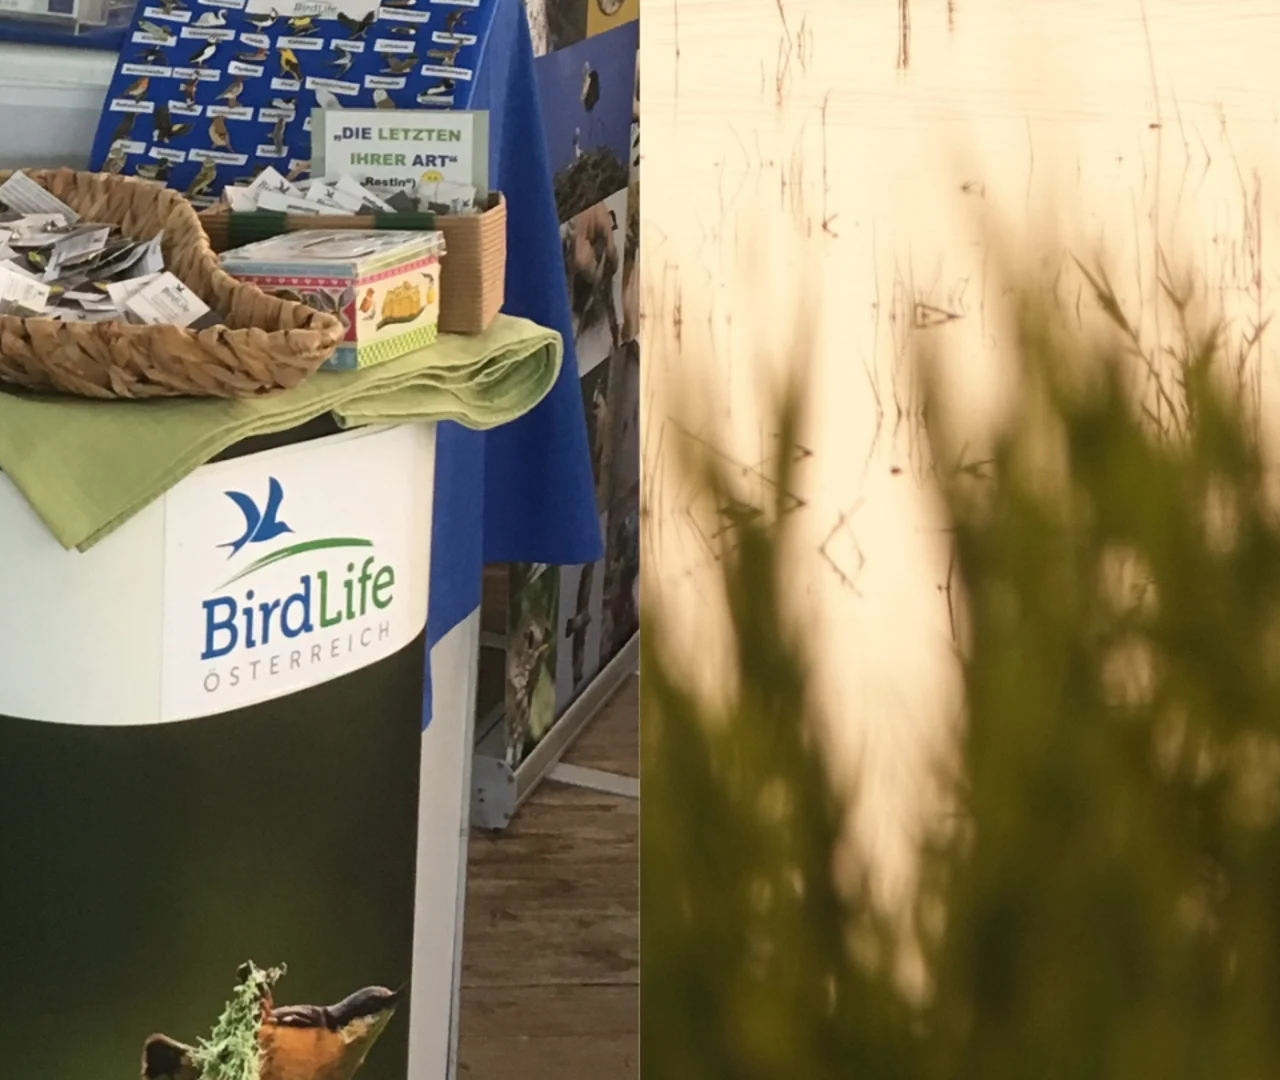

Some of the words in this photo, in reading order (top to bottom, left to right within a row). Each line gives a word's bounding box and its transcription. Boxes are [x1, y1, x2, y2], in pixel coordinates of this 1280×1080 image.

[378, 127, 462, 142] LETZTEN
[350, 152, 407, 166] IHRER
[200, 556, 395, 660] BirdLife
[203, 620, 390, 693] ÖSTERREICH
